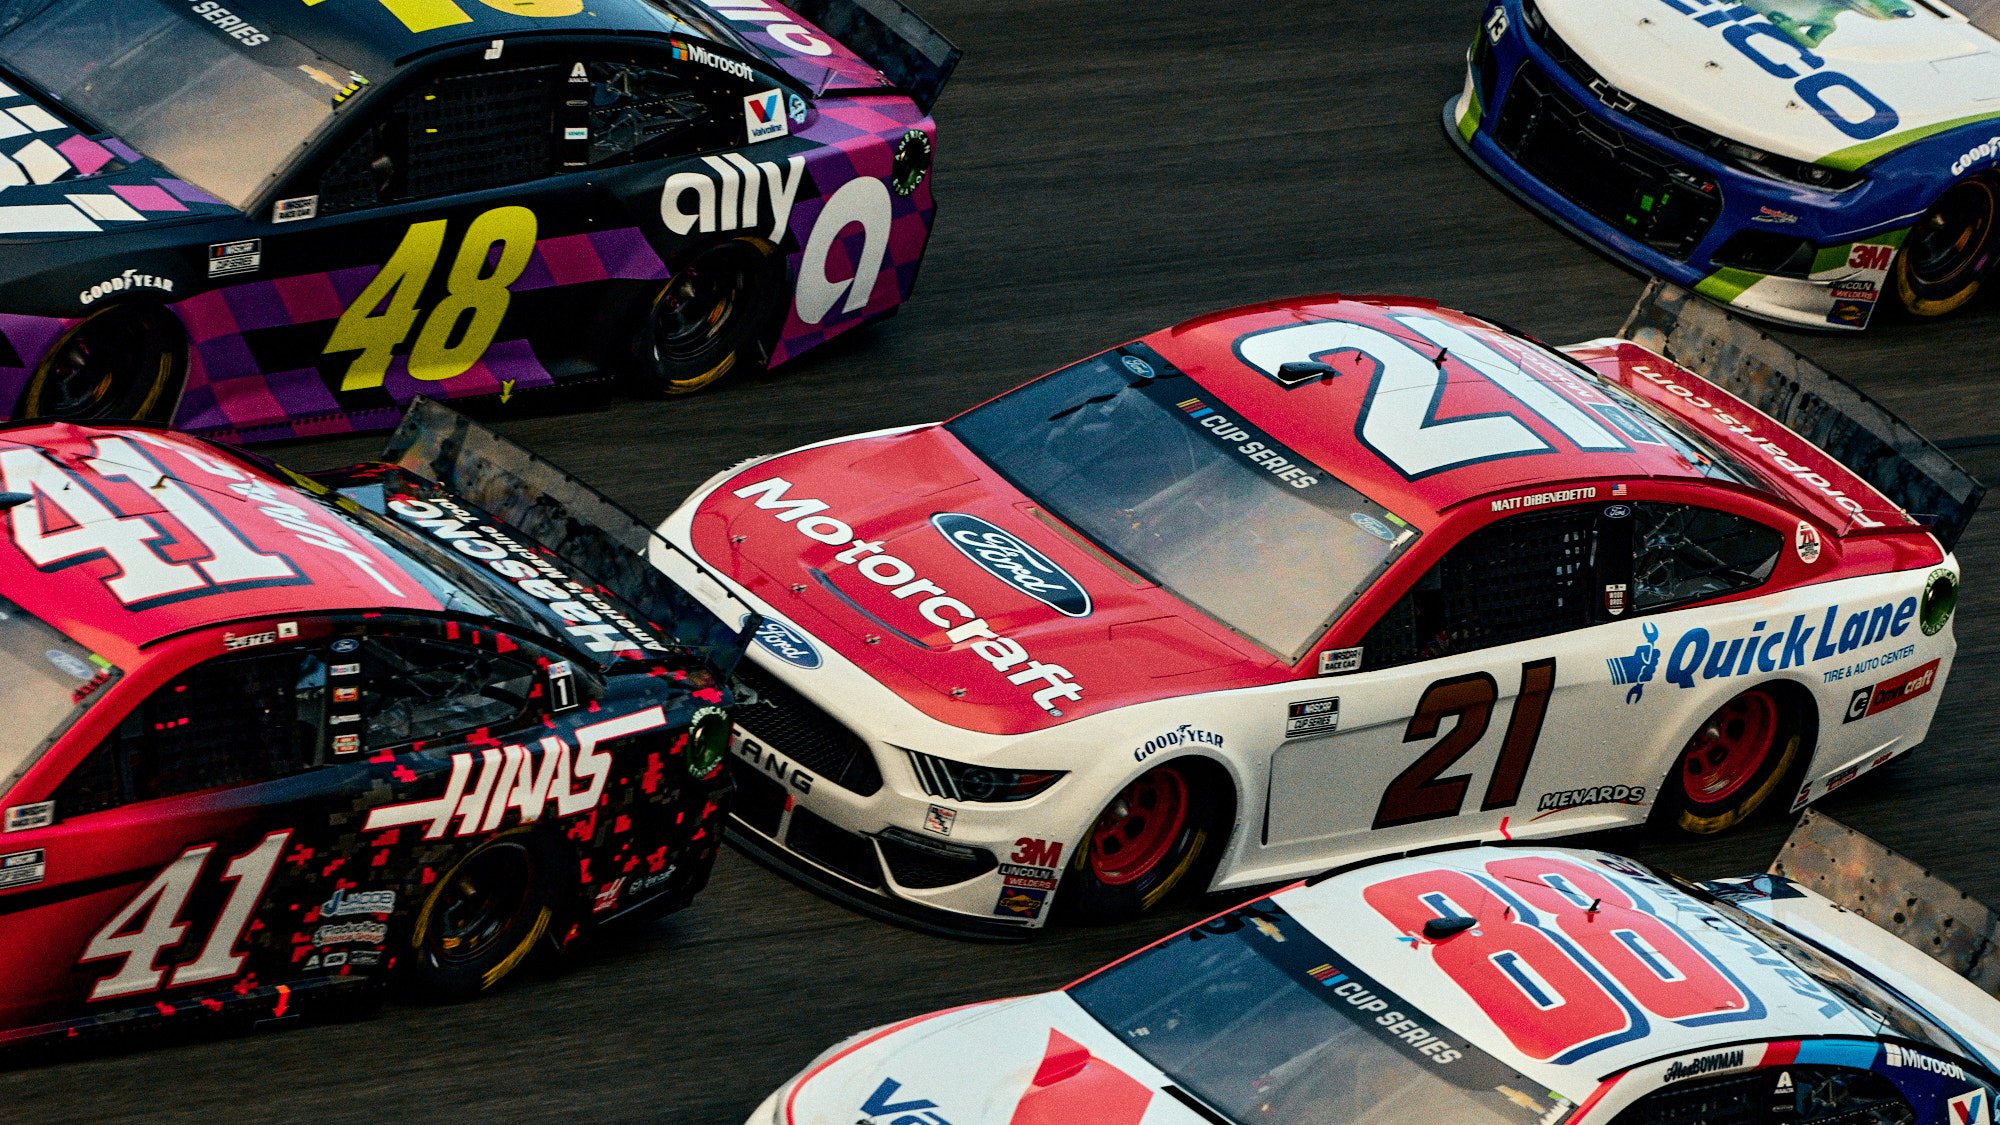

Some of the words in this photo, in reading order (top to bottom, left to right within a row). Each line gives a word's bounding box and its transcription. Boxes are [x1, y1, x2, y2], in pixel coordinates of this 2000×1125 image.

[192, 1, 270, 47] SERIES
[1485, 7, 1508, 46] 13
[687, 43, 755, 82] Microsoft
[752, 123, 782, 138] Valvoline
[660, 153, 806, 245] ally
[1848, 245, 1893, 271] 3M
[80, 269, 174, 304] GOODYEAR
[323, 205, 538, 391] 48
[1127, 359, 1152, 376] Ford
[1231, 314, 1636, 484] 21
[1201, 413, 1251, 443] CUP
[1238, 440, 1319, 490] SERIES
[0, 435, 314, 612] 41
[427, 497, 480, 522] Tool
[1491, 497, 1523, 512] MATT
[479, 525, 569, 581] Machine
[953, 530, 1068, 595] Ford
[733, 476, 1084, 713] Motorcraft
[760, 621, 809, 661] Ford
[1324, 662, 1342, 671] RACE
[1342, 660, 1357, 668] CAR
[1823, 667, 1845, 684] TIRE
[1845, 665, 1853, 678] &
[1854, 657, 1880, 675] AUTO
[1880, 644, 1915, 667] CENTER
[1874, 668, 1934, 705] Omnicraft
[1305, 701, 1333, 714] NASCAR
[1134, 724, 1224, 763] GOODYEAR
[1370, 656, 1557, 830] 21
[361, 706, 667, 841] HAAS
[1537, 784, 1646, 812] MENARDS
[1001, 865, 1050, 879] LINCOLN
[1010, 836, 1064, 869] 3M
[1009, 877, 1052, 889] WELDERS
[79, 828, 294, 1002] 41
[1362, 855, 1768, 1065] 88
[1333, 980, 1385, 1014] CUP
[1375, 1010, 1463, 1066] SERIES
[1900, 1046, 1967, 1081] Microsoft
